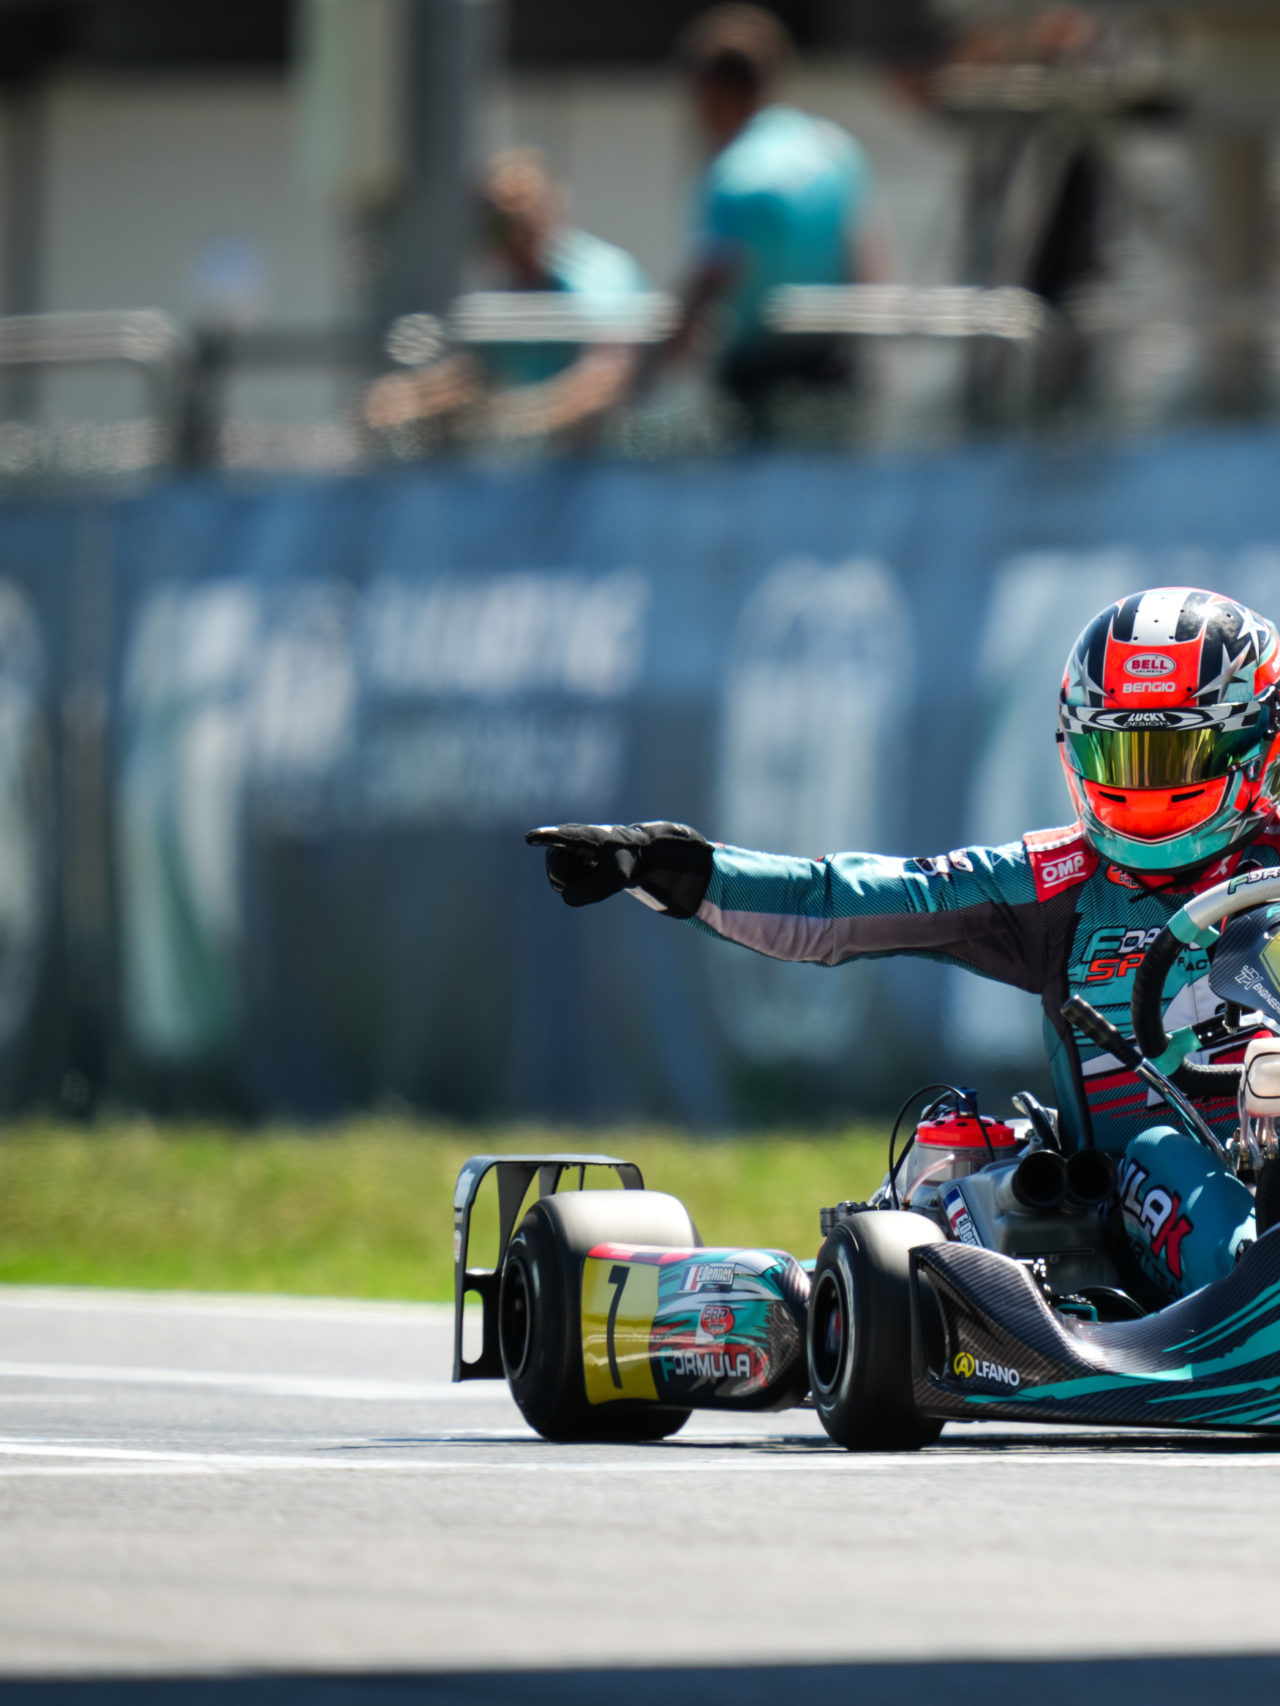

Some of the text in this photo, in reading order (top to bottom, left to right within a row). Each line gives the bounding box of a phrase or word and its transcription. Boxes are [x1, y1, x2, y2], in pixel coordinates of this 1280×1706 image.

[1132, 660, 1167, 669] BELL
[1122, 682, 1176, 693] BENGIO
[1127, 712, 1167, 722] LUCKY
[1041, 856, 1084, 881] OMP
[607, 1264, 630, 1389] 7
[954, 1351, 1020, 1386] ALFANO
